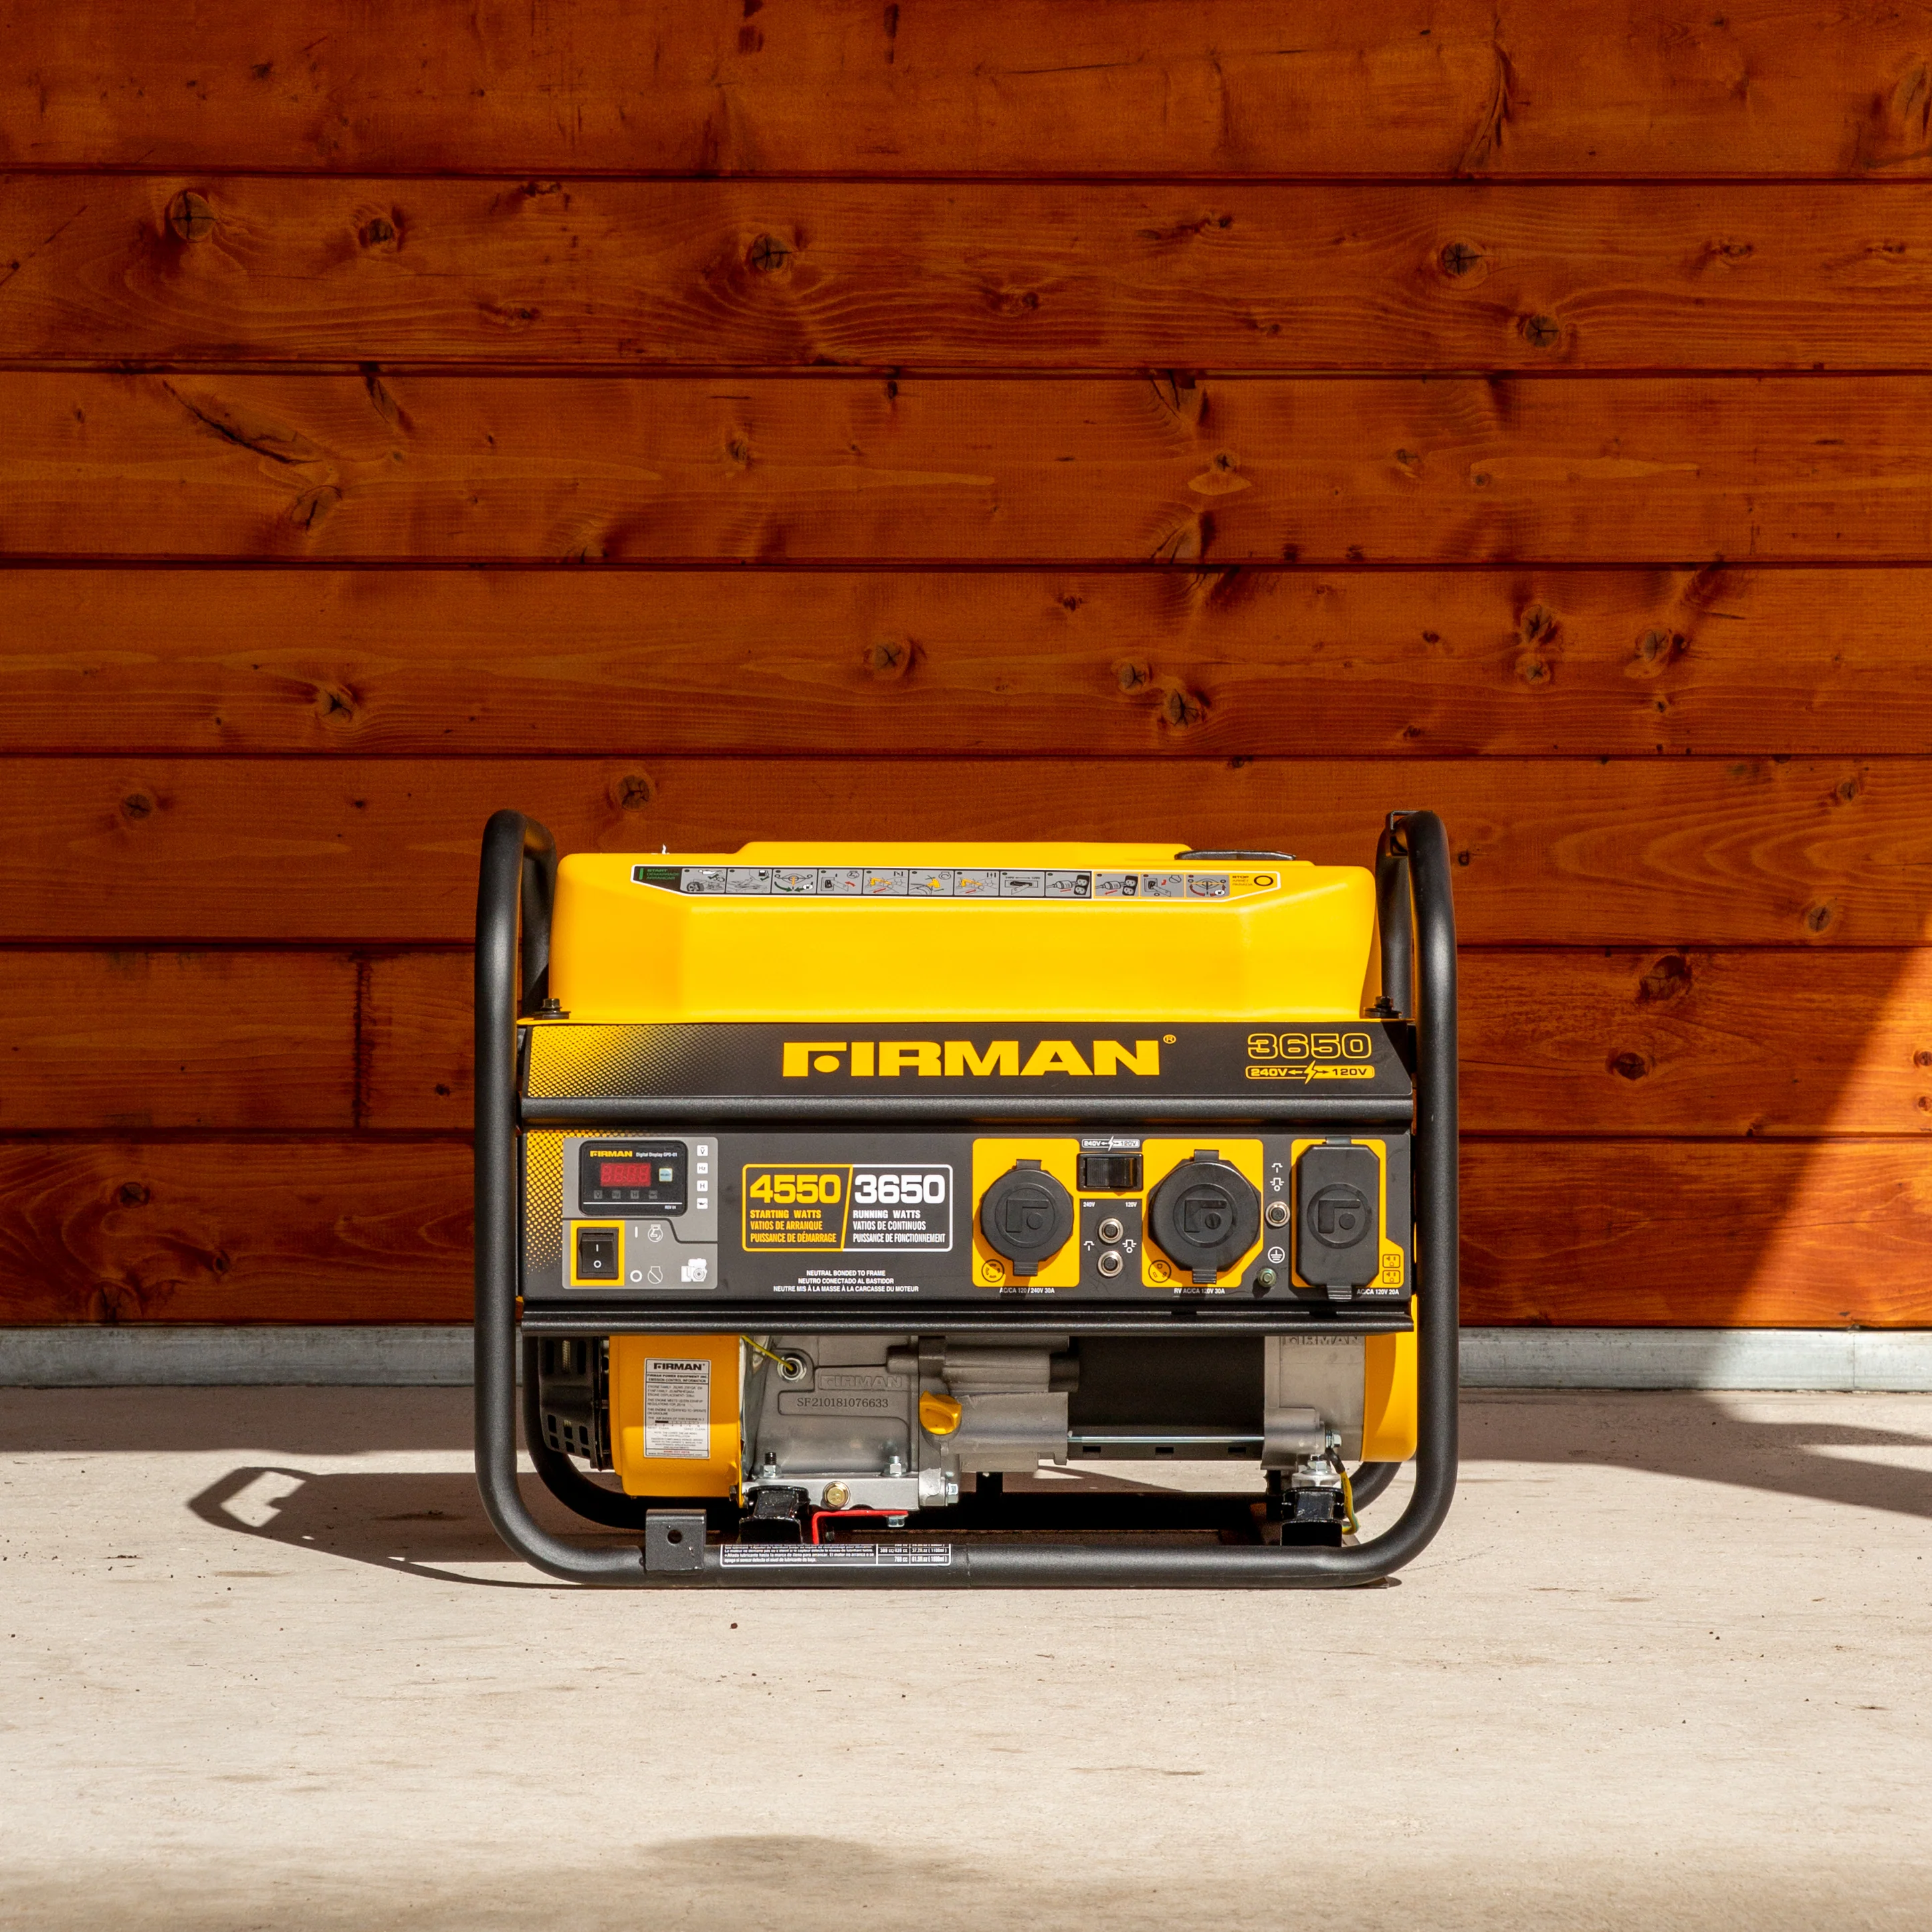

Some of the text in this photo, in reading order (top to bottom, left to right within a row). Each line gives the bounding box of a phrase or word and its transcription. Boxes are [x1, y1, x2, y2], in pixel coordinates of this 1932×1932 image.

[1247, 1033, 1372, 1059] 3650
[1251, 1068, 1368, 1077] 240V 120V
[750, 1174, 946, 1204] 4550 3650
[750, 1210, 822, 1218] STARTING WATTS
[853, 1210, 921, 1218] RUNNING WATTS
[750, 1220, 823, 1230] VATIOS DE ARRANQUE
[853, 1221, 926, 1230] VATIOS DE CONTINUOS
[750, 1231, 837, 1243] PUISSANCE DE DÉMARRAGE
[853, 1233, 946, 1243] PUISSANCE DE FONCTIONNEMENT
[821, 1375, 901, 1388] FIRMAN
[796, 1398, 889, 1408] SF210181076633
